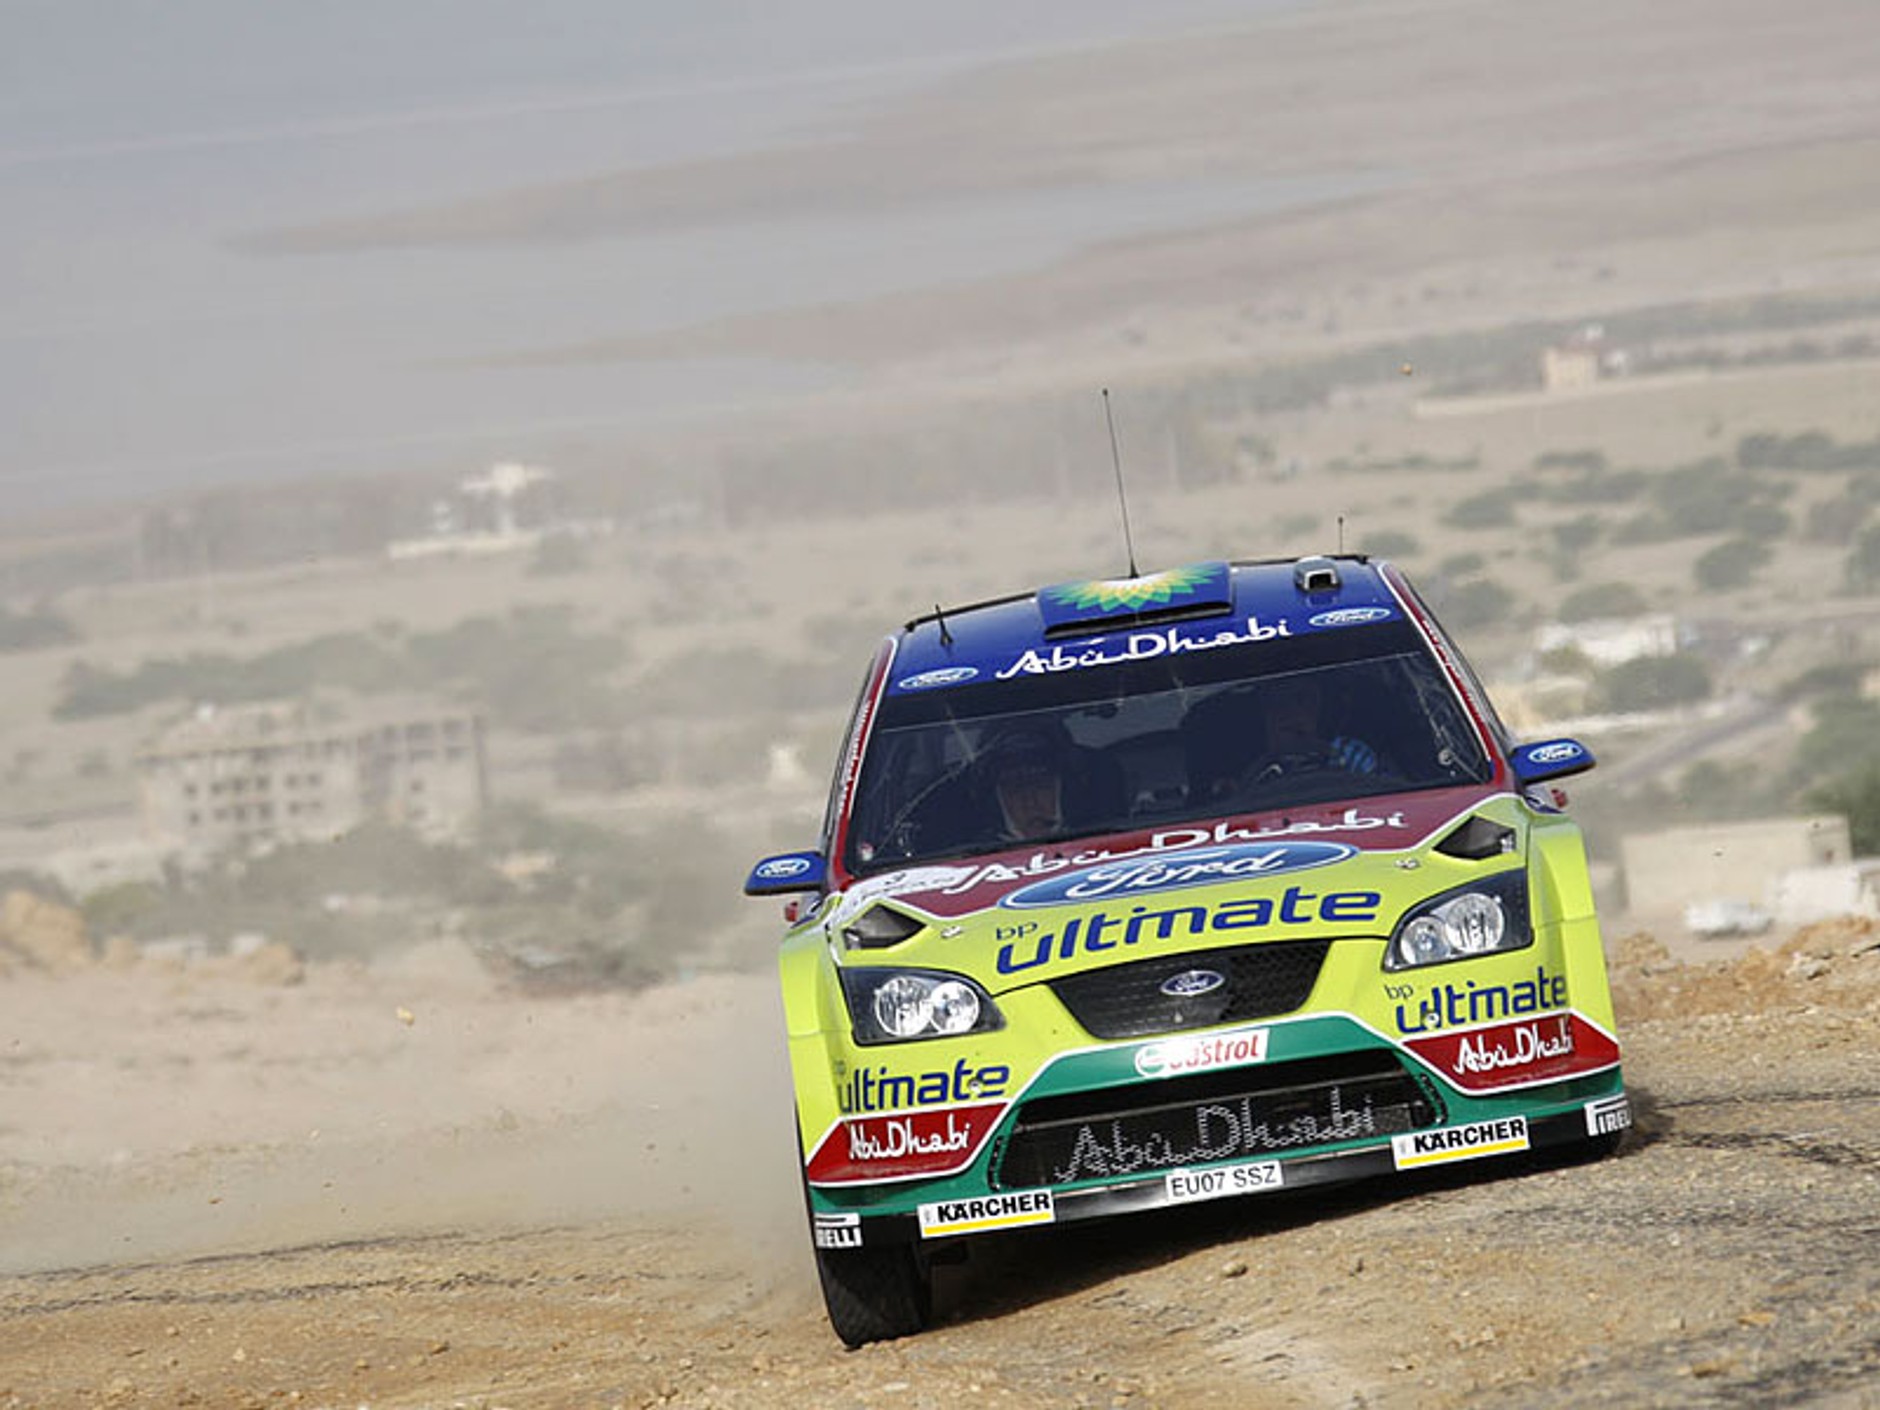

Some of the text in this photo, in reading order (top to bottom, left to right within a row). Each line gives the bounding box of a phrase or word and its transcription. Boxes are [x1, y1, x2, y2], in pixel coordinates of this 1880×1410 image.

[1128, 617, 1293, 660] Dhabi
[1065, 848, 1289, 898] Ford
[995, 920, 1038, 941] bp
[997, 886, 1381, 975] ultimate
[1384, 983, 1414, 1000] bp
[1396, 966, 1567, 1035] ultimate
[837, 1058, 1010, 1113] ultimate
[1413, 1118, 1525, 1154] KÄRCHER
[1170, 1165, 1279, 1197] EU07 SSZ
[937, 1193, 1051, 1223] KÄRCHER
